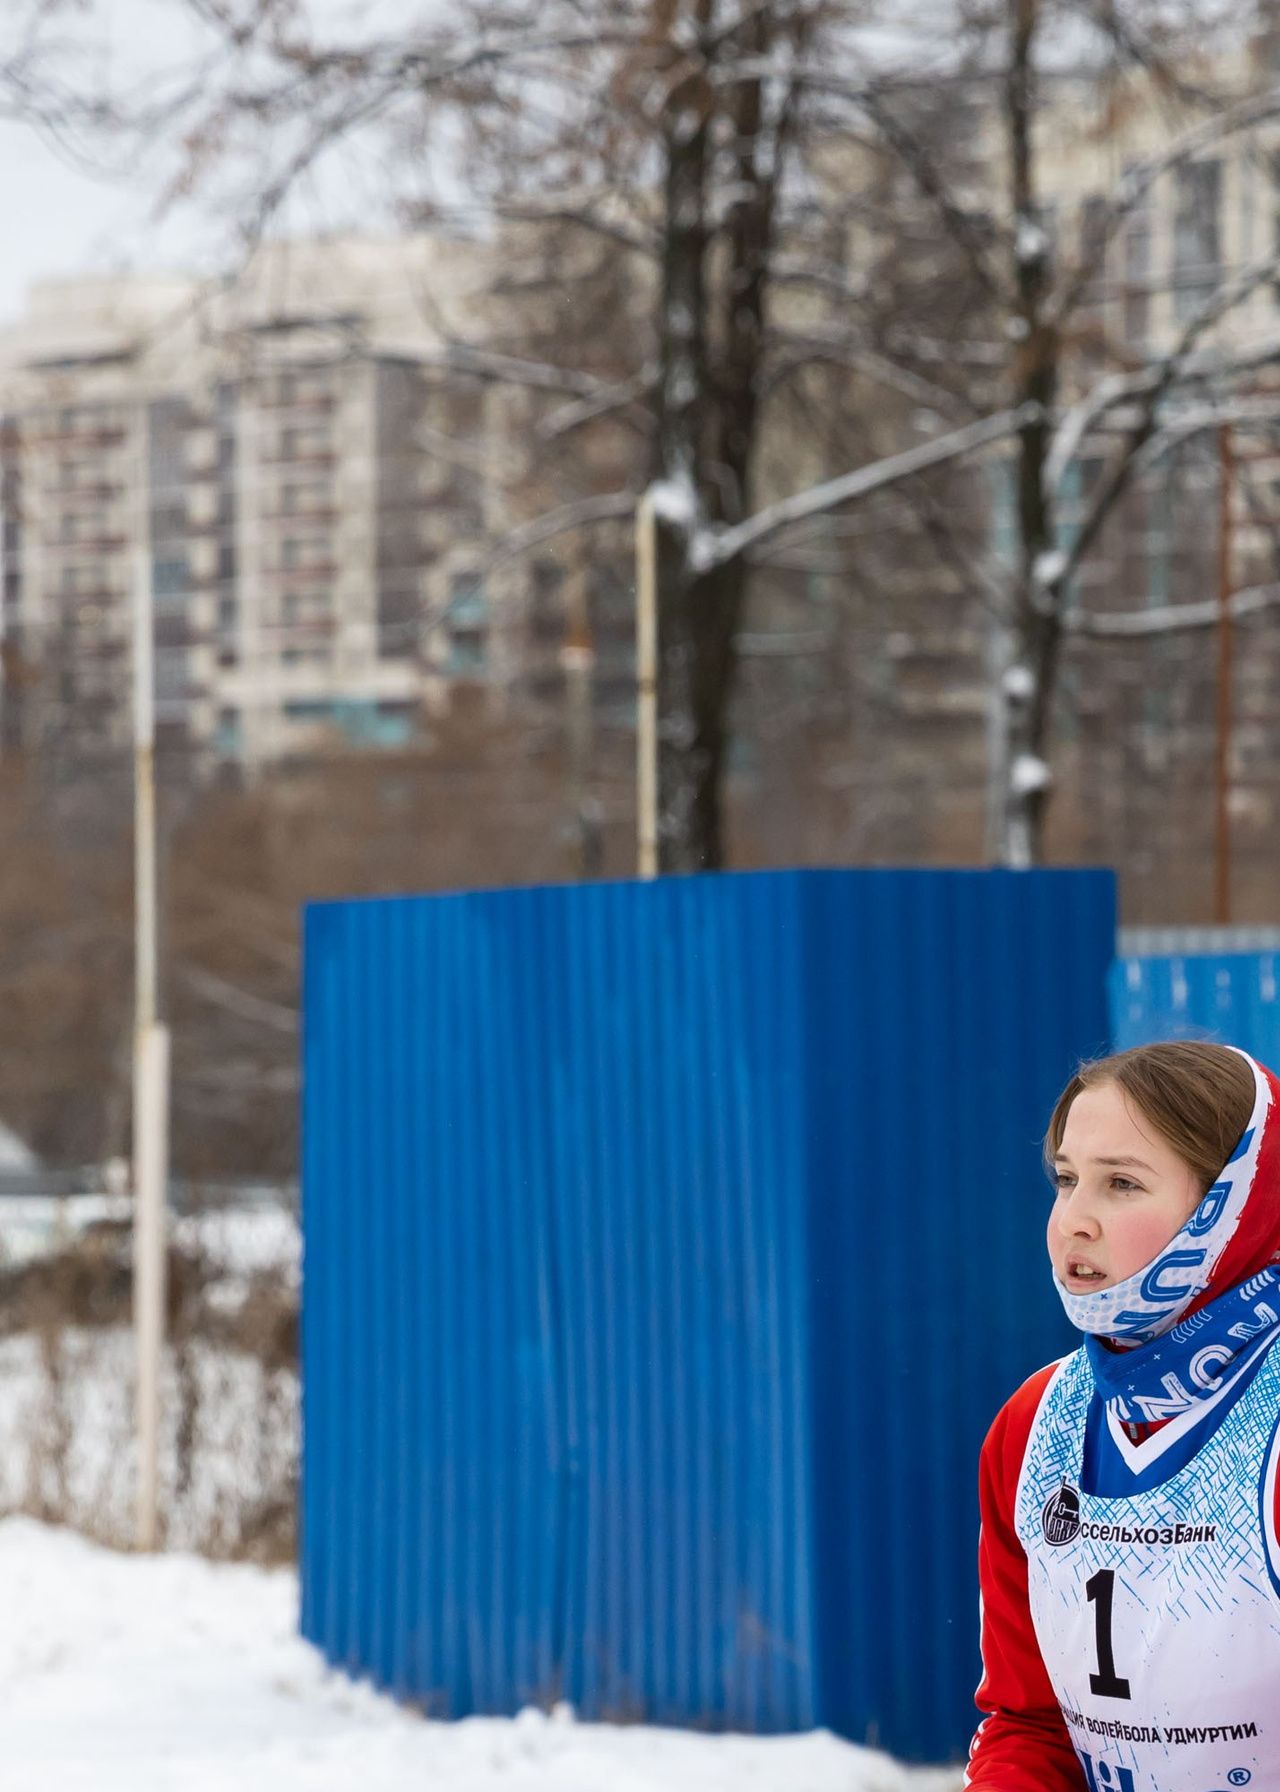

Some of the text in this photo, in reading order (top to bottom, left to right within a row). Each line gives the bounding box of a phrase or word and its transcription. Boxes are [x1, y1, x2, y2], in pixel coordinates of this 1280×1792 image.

[1081, 1522, 1217, 1545] ссельхозБанк
[1085, 1568, 1132, 1700] 1
[1085, 1717, 1162, 1744] ВОЛЕЙБОЛА
[1163, 1721, 1258, 1745] УДМУРТИИ
